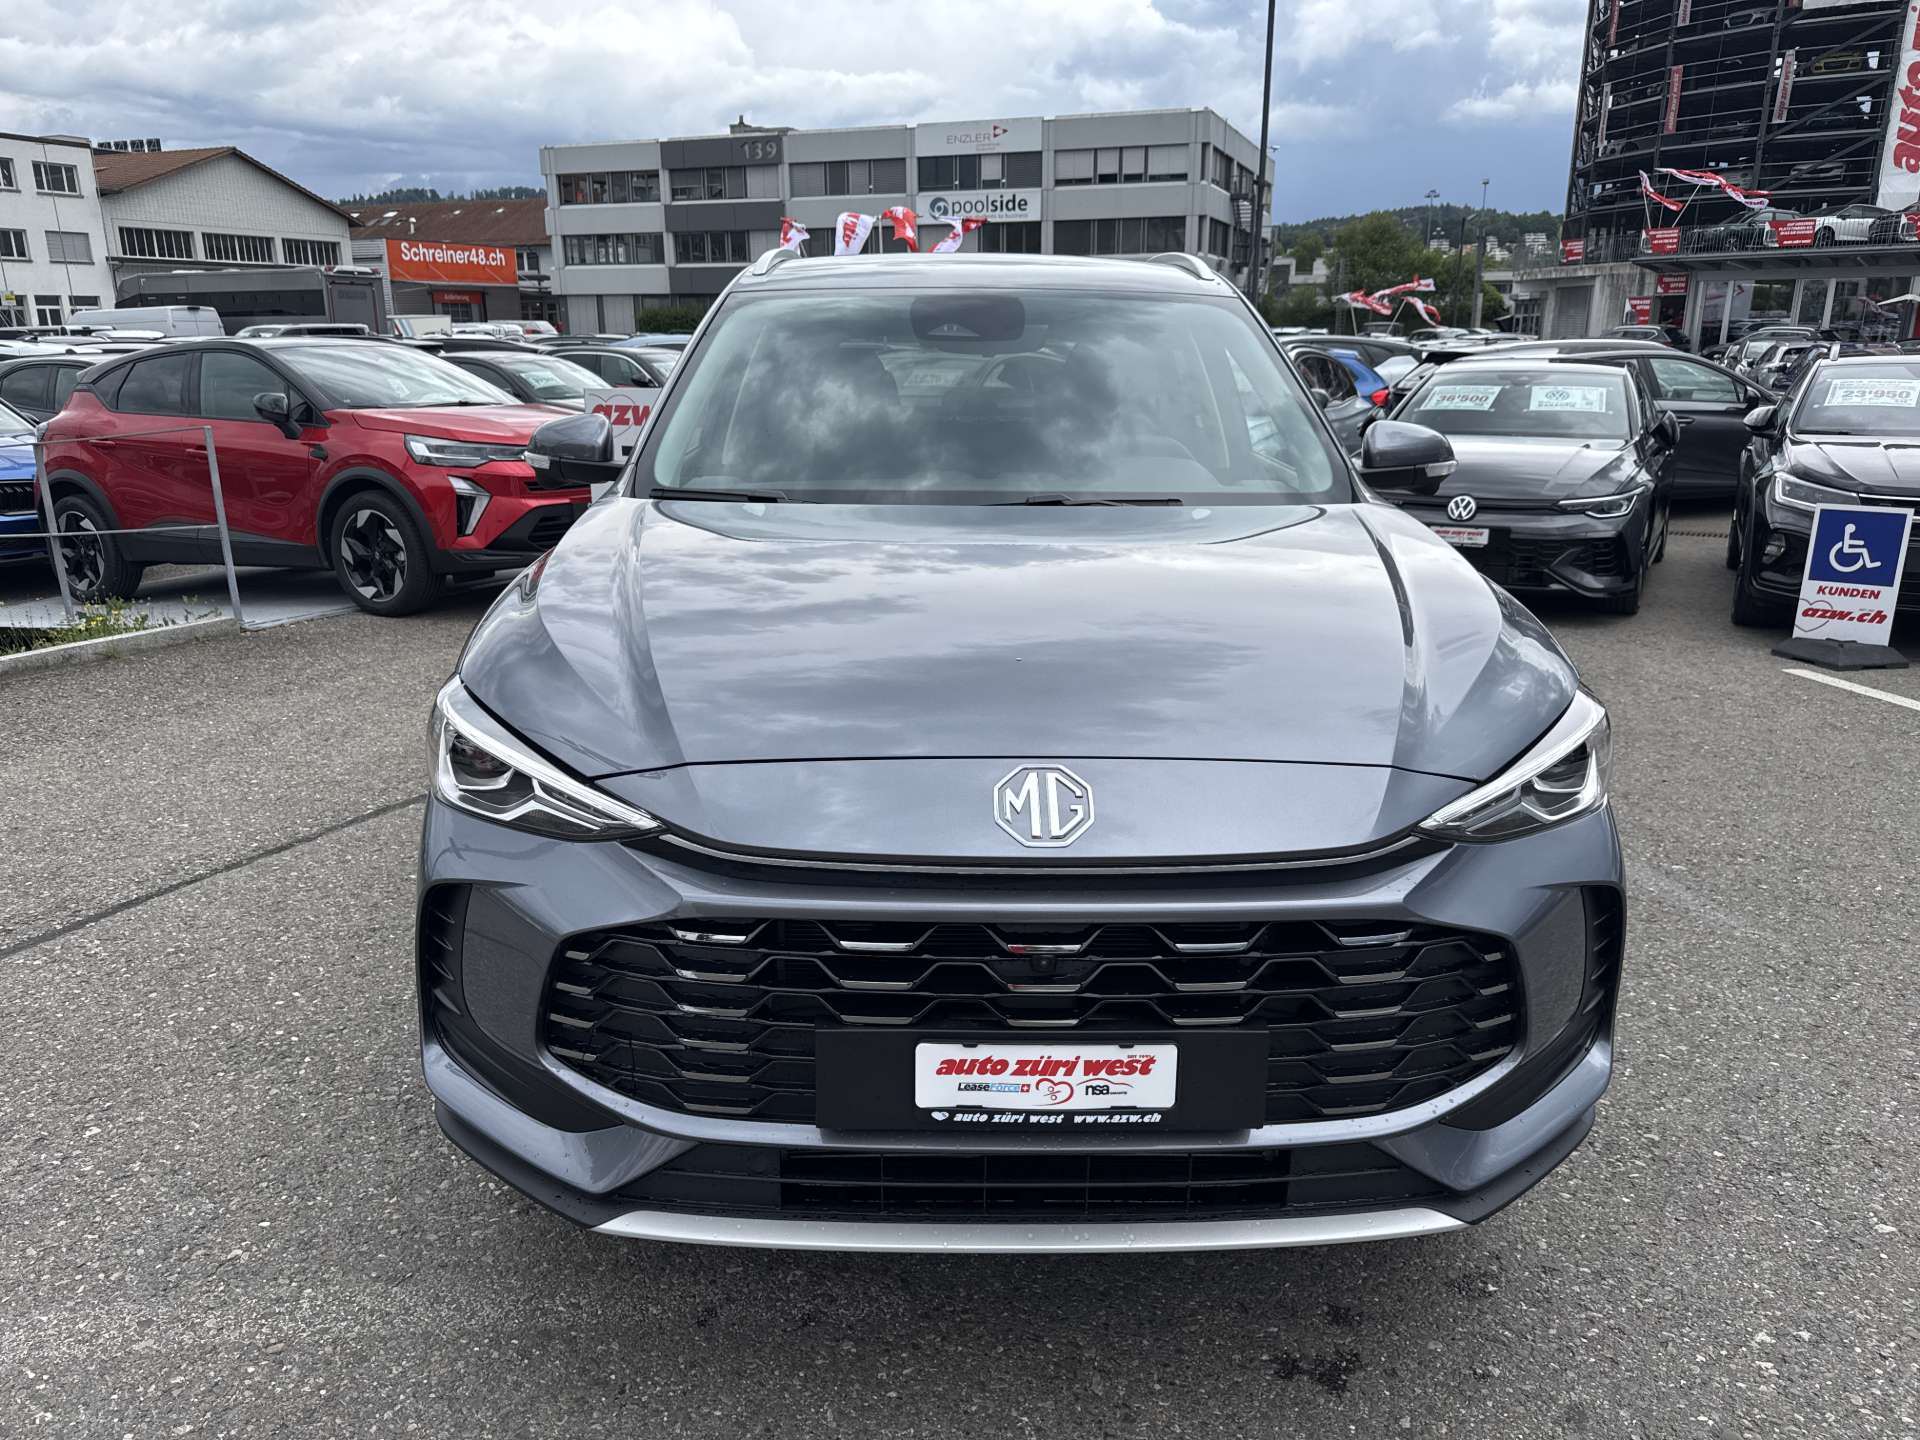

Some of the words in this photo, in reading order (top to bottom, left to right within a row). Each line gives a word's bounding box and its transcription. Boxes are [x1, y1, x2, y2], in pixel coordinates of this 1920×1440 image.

[946, 132, 992, 145] ENZLER
[741, 141, 777, 161] 139
[951, 194, 1028, 217] poolside
[401, 241, 506, 266] Schreiner48.ch
[1841, 390, 1911, 399] 23'950
[1817, 585, 1881, 600] KUNDEN
[1802, 607, 1888, 625] azw.ch
[1003, 771, 1084, 839] MG
[936, 1055, 1010, 1076] auto
[1010, 1055, 1081, 1077] züri
[1083, 1055, 1157, 1077] west
[958, 1083, 1021, 1092] LeaseForce
[1085, 1085, 1109, 1095] nsa
[954, 1112, 989, 1122] auto
[991, 1112, 1026, 1124] züri
[1029, 1112, 1065, 1123] west
[1073, 1112, 1162, 1123] www.azw.ch
